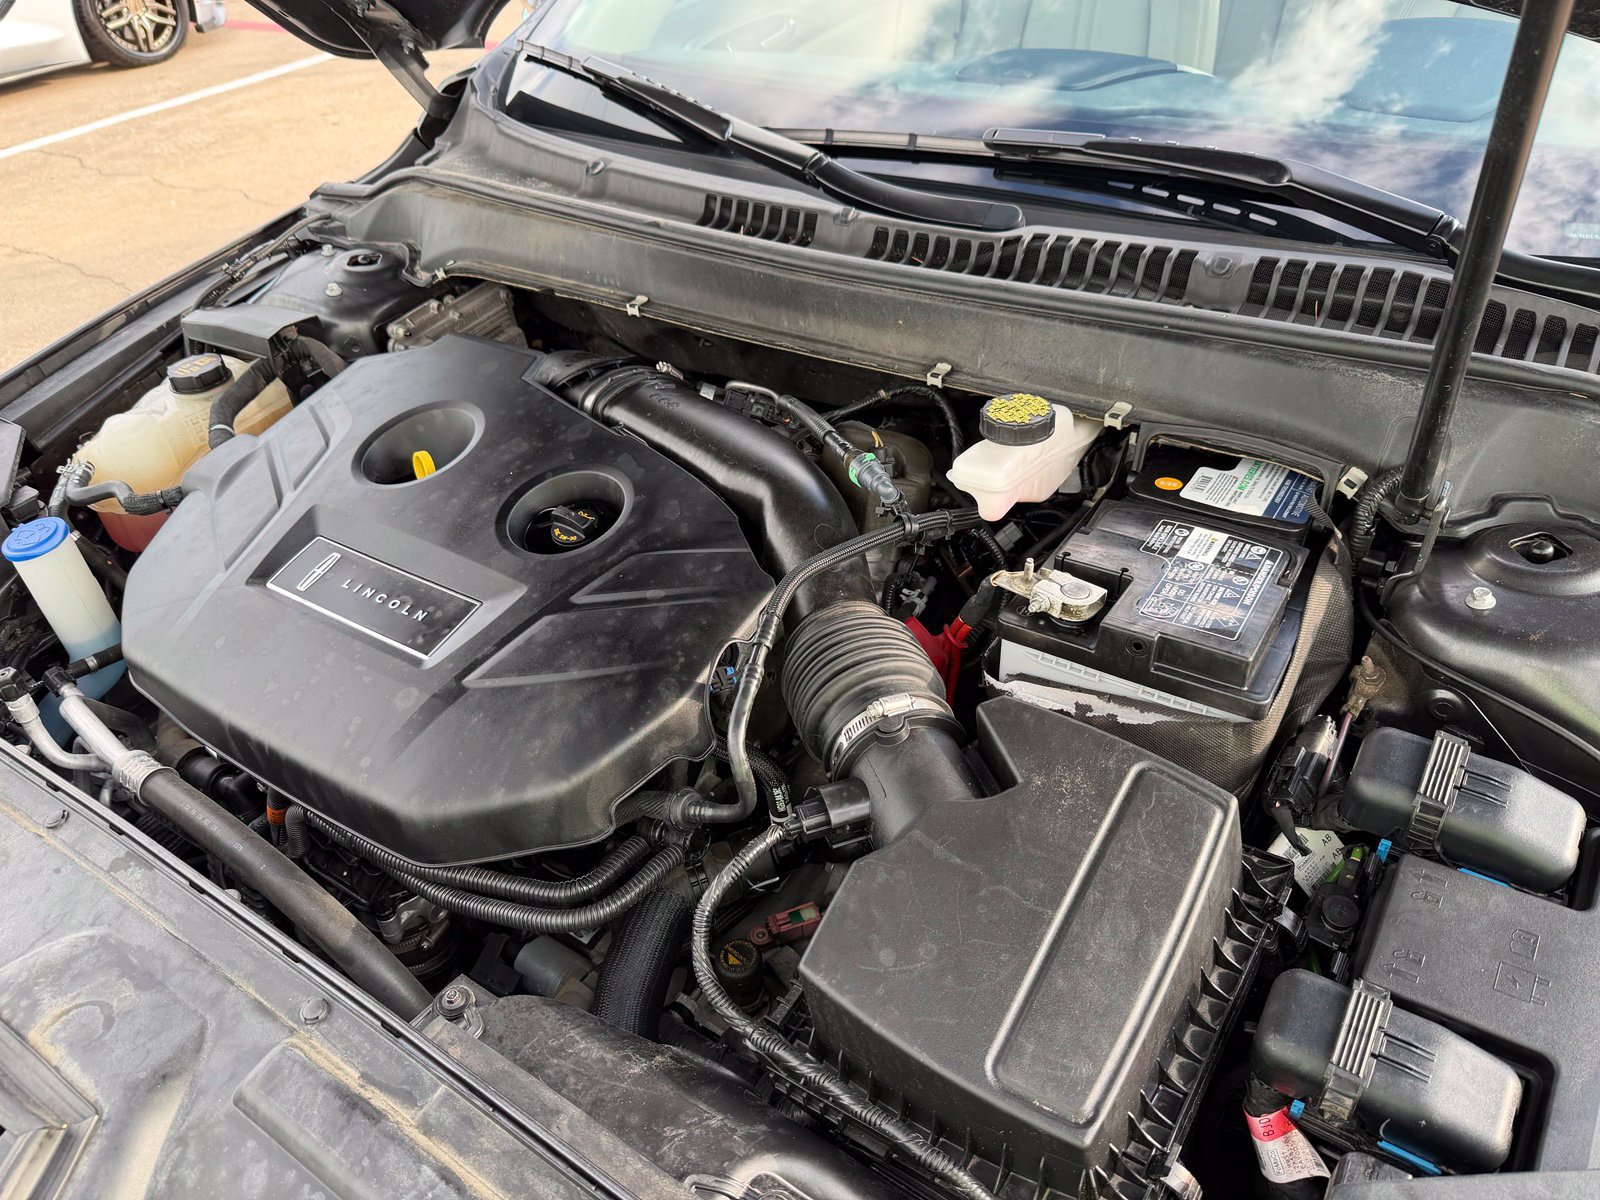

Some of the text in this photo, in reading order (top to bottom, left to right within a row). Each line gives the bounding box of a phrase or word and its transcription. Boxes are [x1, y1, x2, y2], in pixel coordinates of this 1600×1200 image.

[340, 578, 428, 622] LINCOLN
[1321, 834, 1332, 846] AB
[1270, 1151, 1282, 1175] FoMoCo
